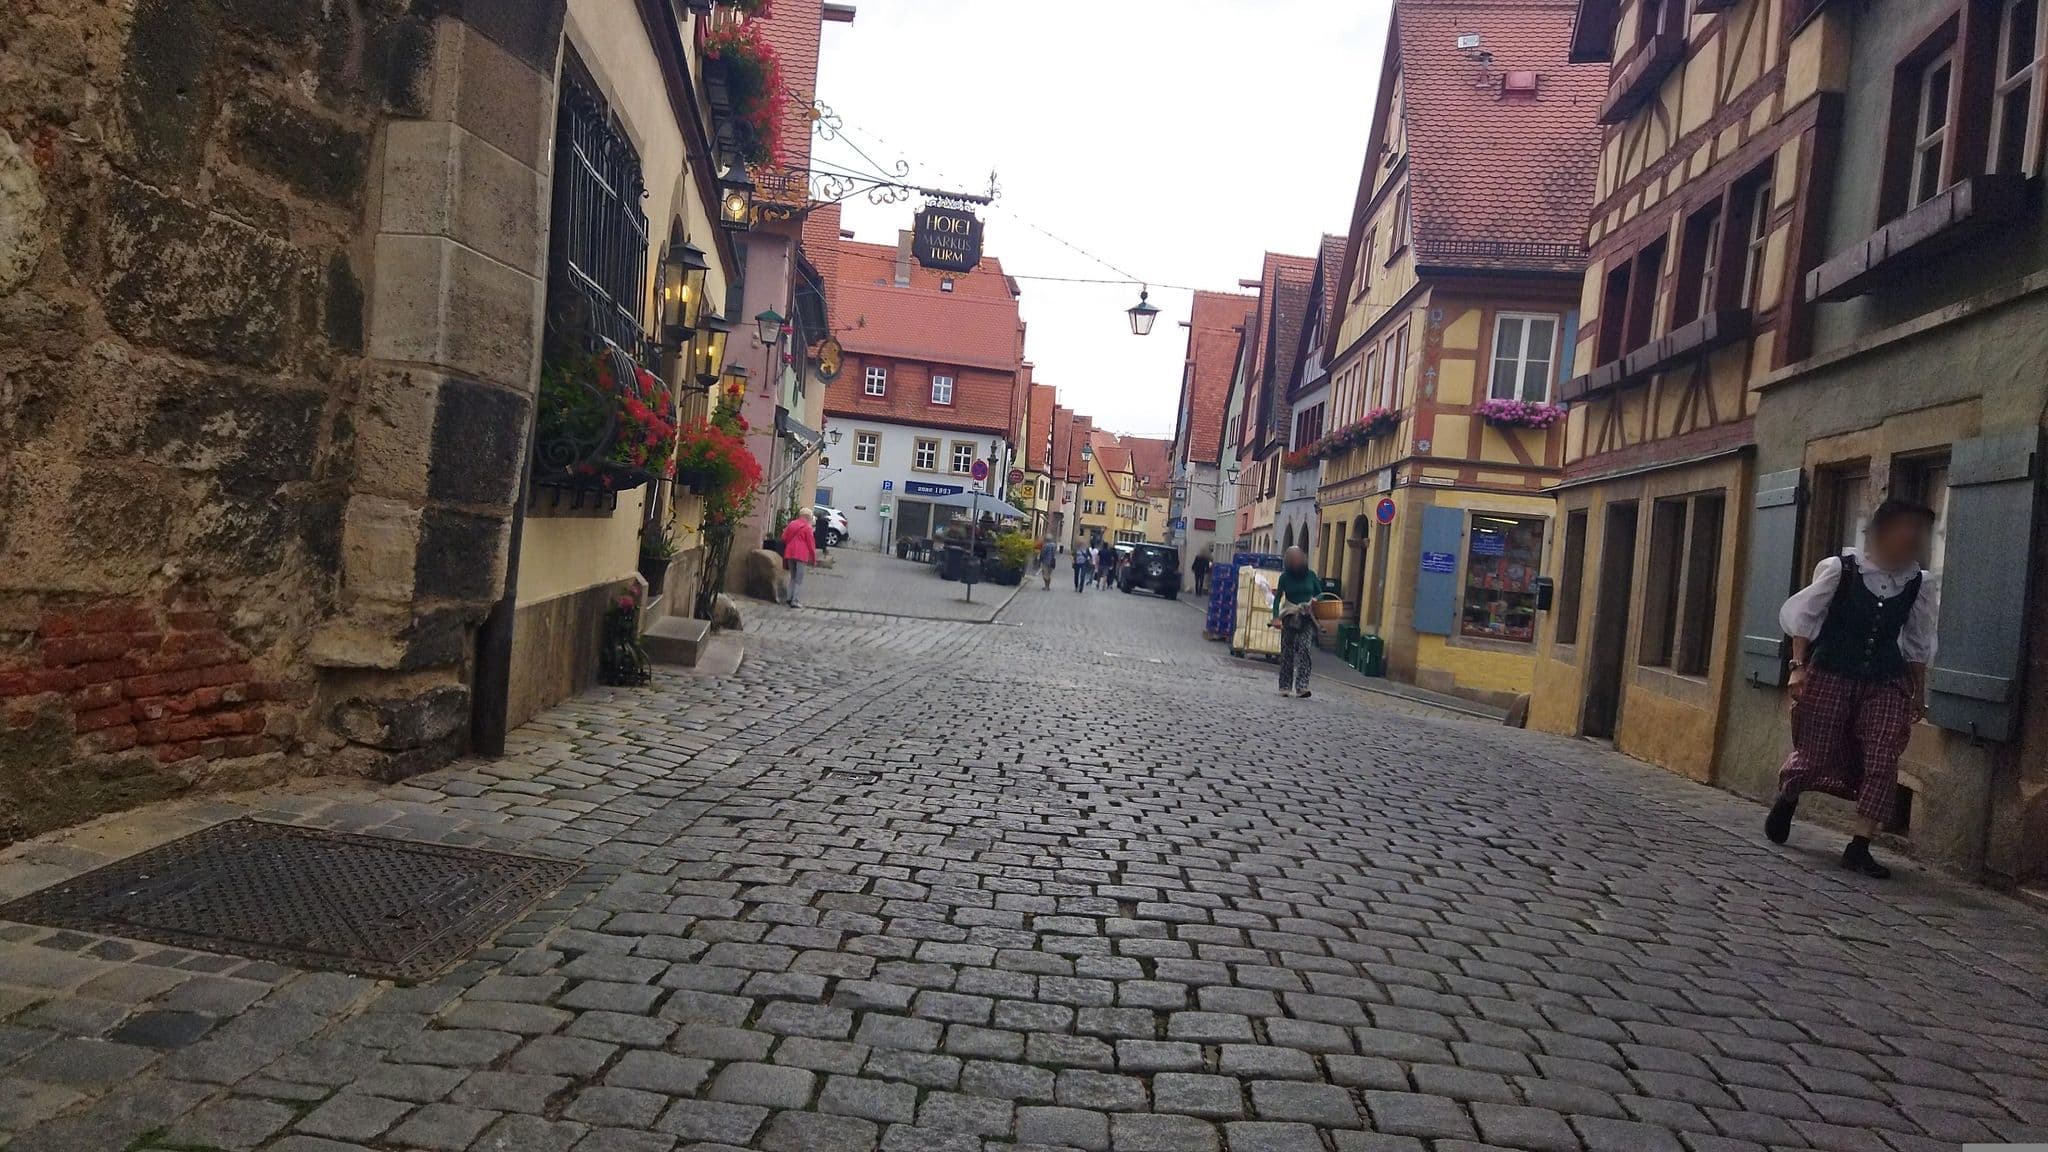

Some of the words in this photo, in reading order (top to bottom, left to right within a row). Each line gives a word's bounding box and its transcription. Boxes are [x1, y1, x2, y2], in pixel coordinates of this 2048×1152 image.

[927, 215, 970, 235] HOTEL
[924, 235, 972, 251] MARKUS
[930, 247, 963, 263] TURM
